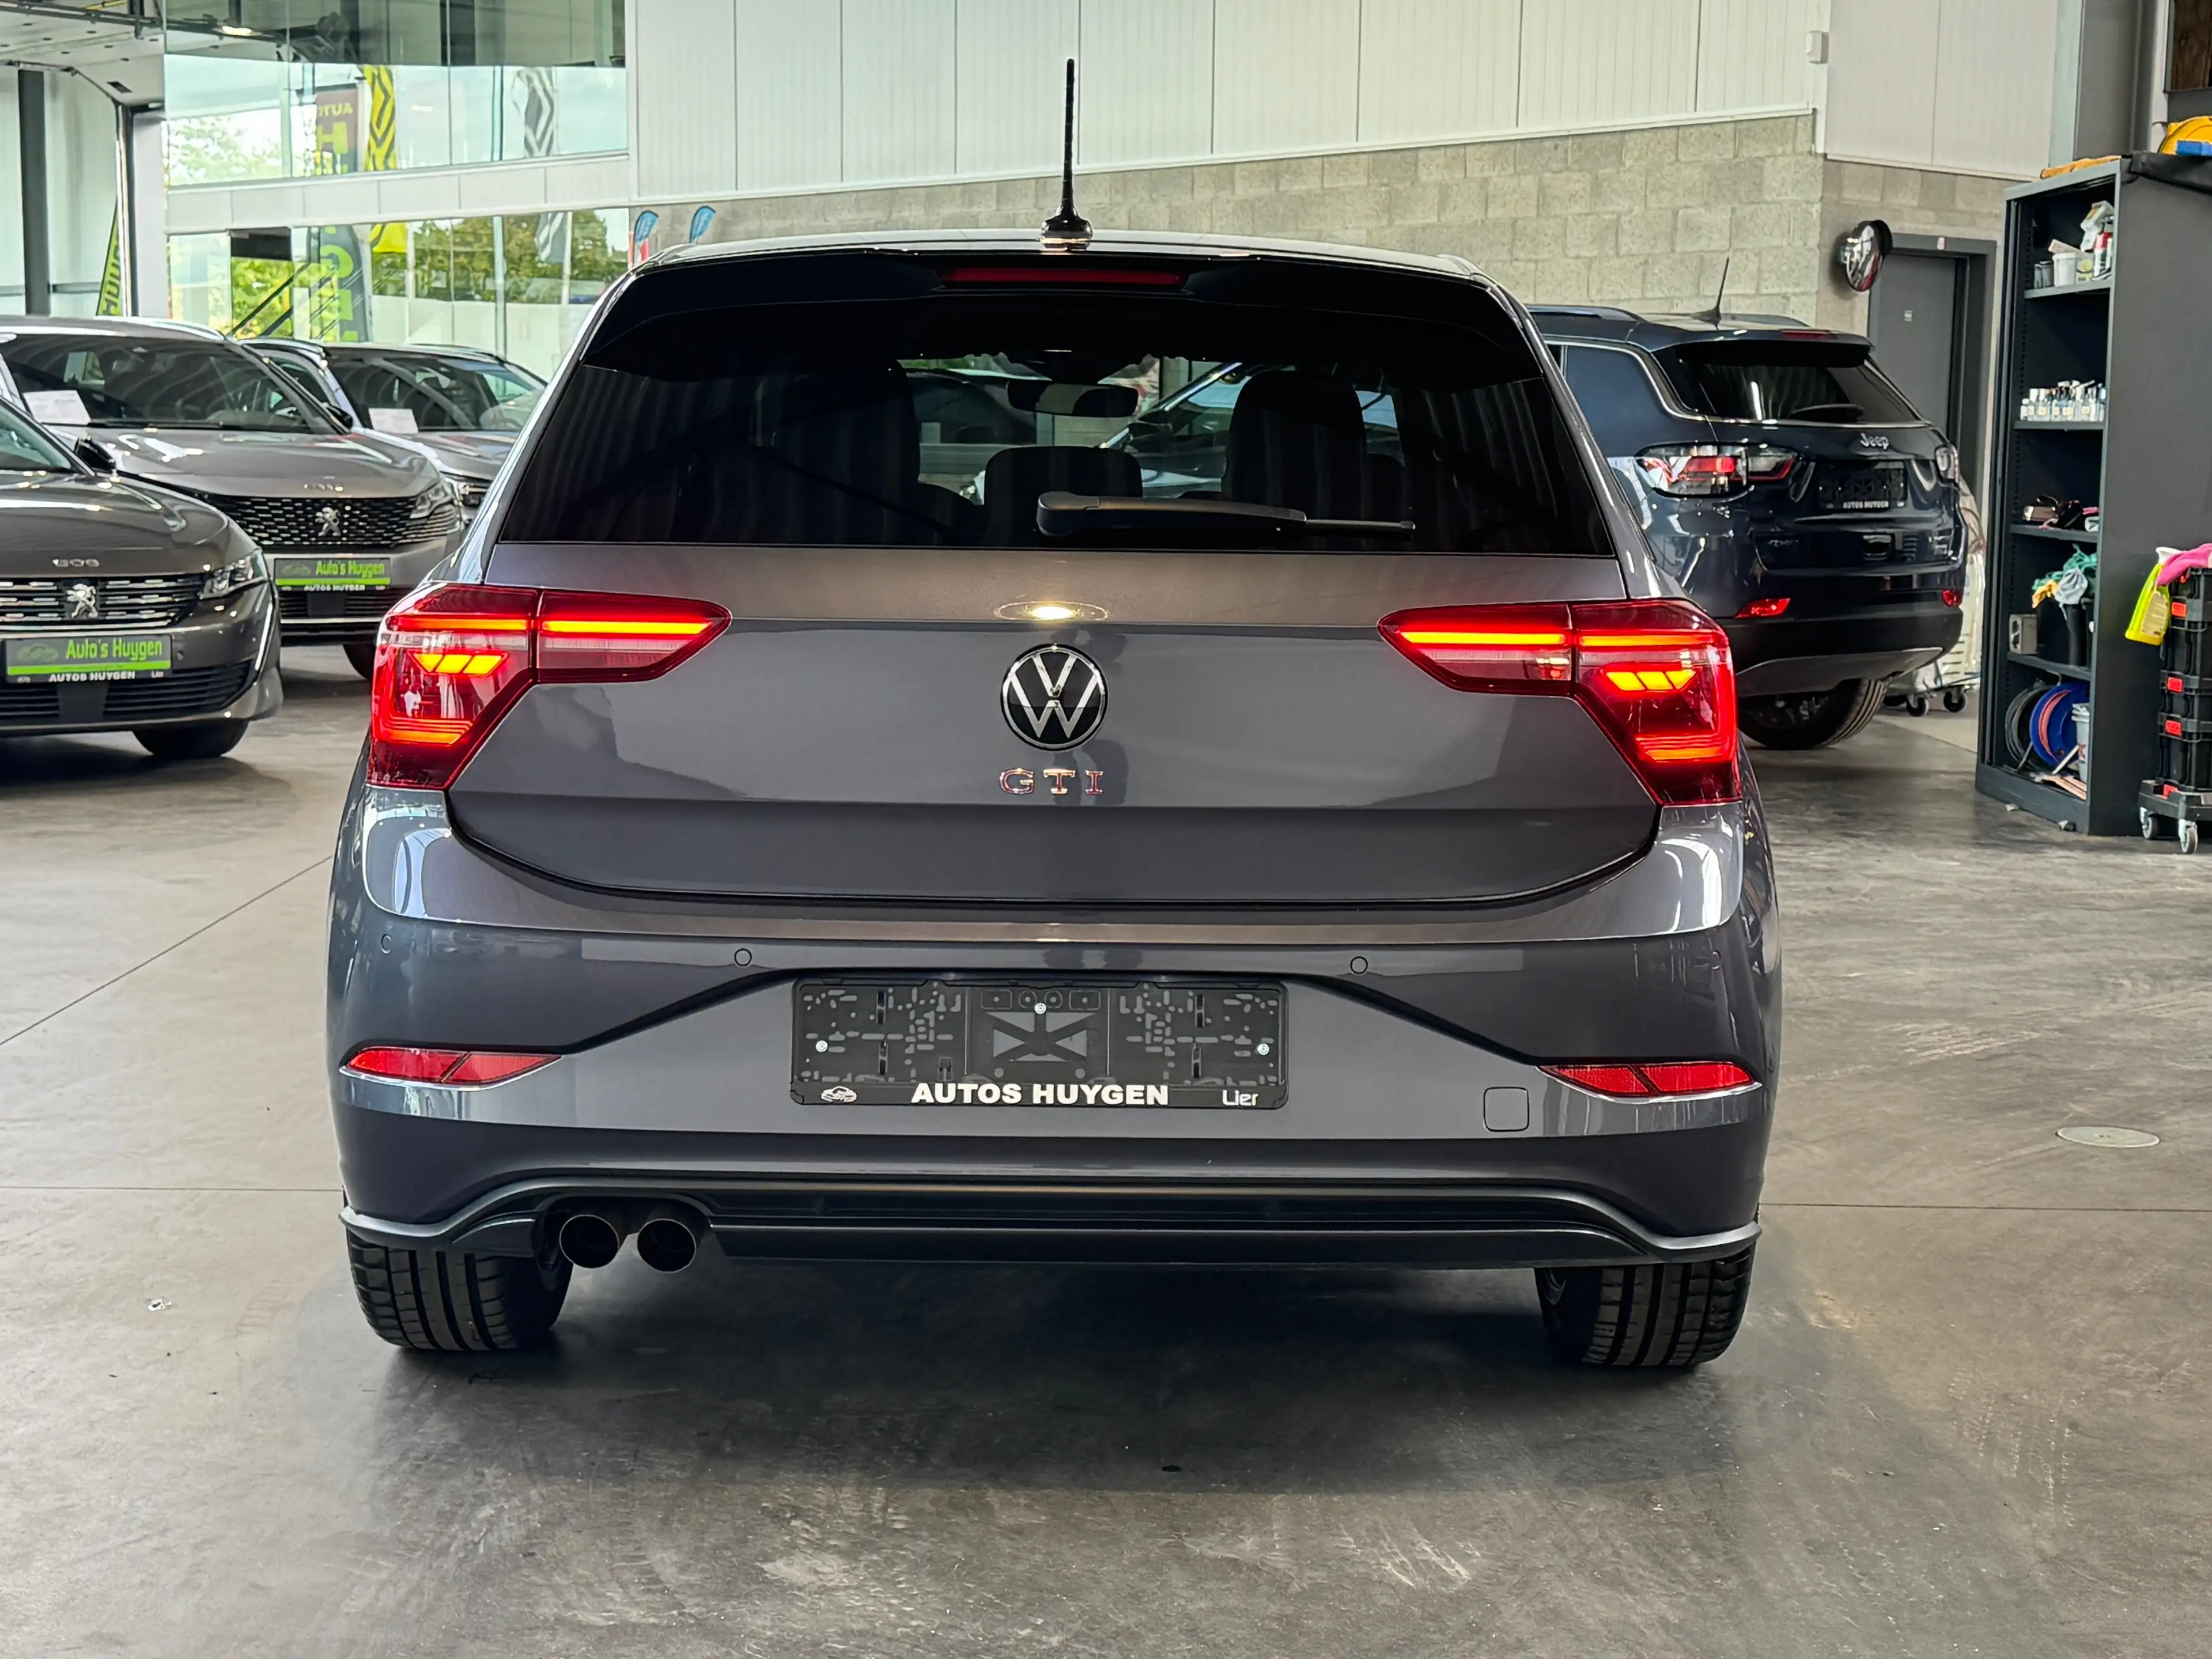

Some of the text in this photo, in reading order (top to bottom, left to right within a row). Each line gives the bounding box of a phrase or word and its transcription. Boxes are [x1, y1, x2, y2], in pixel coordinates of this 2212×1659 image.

[1860, 433, 1889, 450] Jeep
[347, 559, 385, 579] Huygen
[66, 637, 162, 661] Auto's Huygen
[1005, 647, 1104, 746] VW
[999, 767, 1104, 795] GTI
[911, 1082, 1259, 1107] AUTOS HUYGEN Lier
